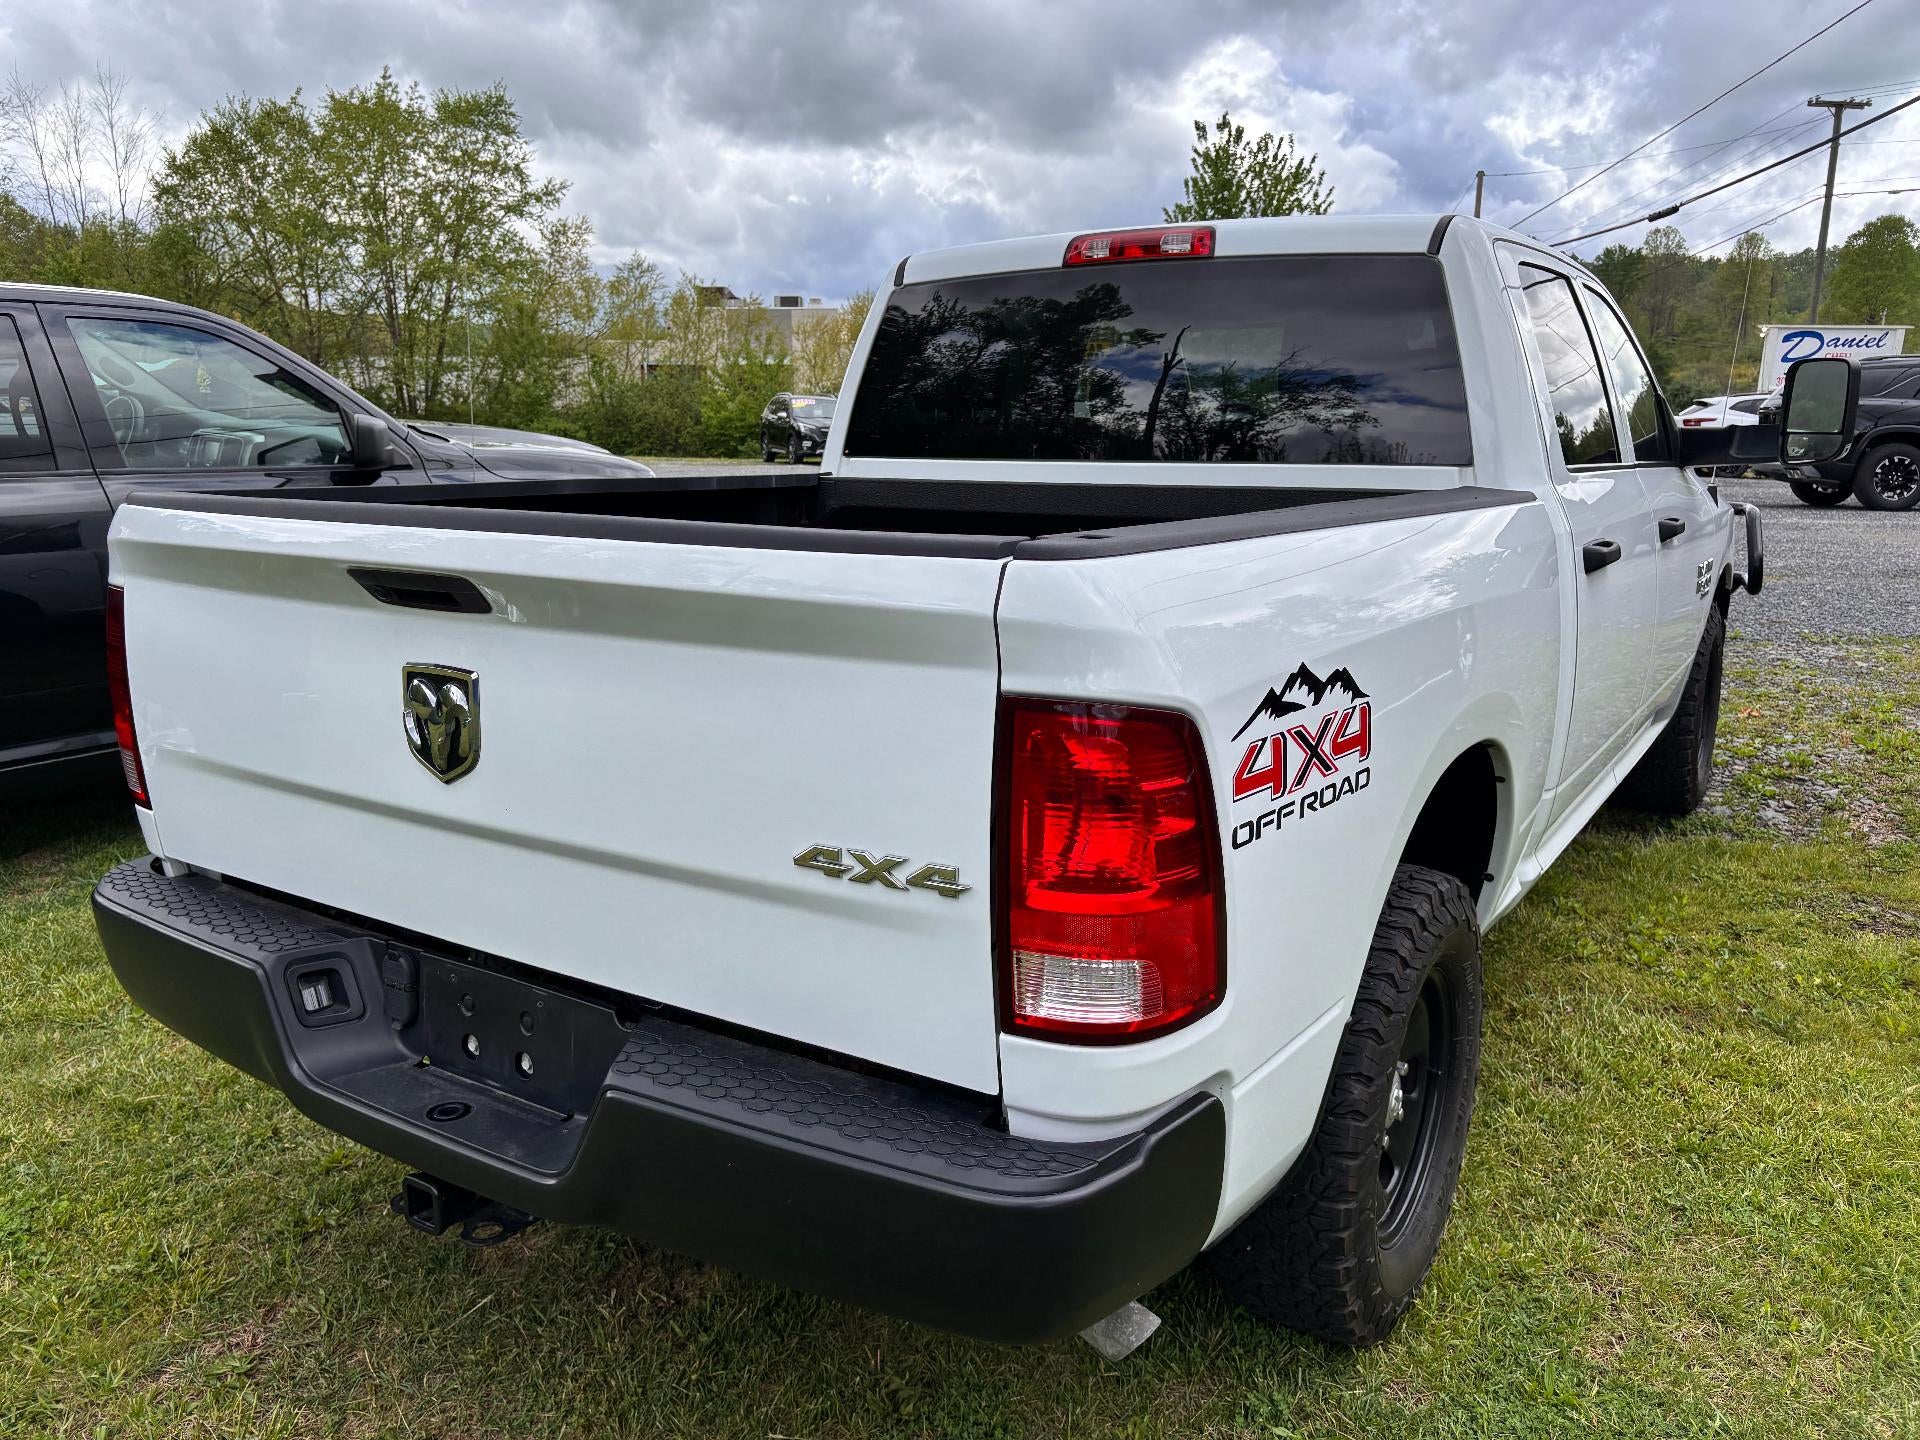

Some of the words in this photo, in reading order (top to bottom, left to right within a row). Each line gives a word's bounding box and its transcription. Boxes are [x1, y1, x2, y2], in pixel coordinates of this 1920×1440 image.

[1781, 330, 1889, 363] Daniel
[1232, 701, 1371, 803] 4X4
[1231, 799, 1296, 850] OFF
[1299, 766, 1370, 819] ROAD
